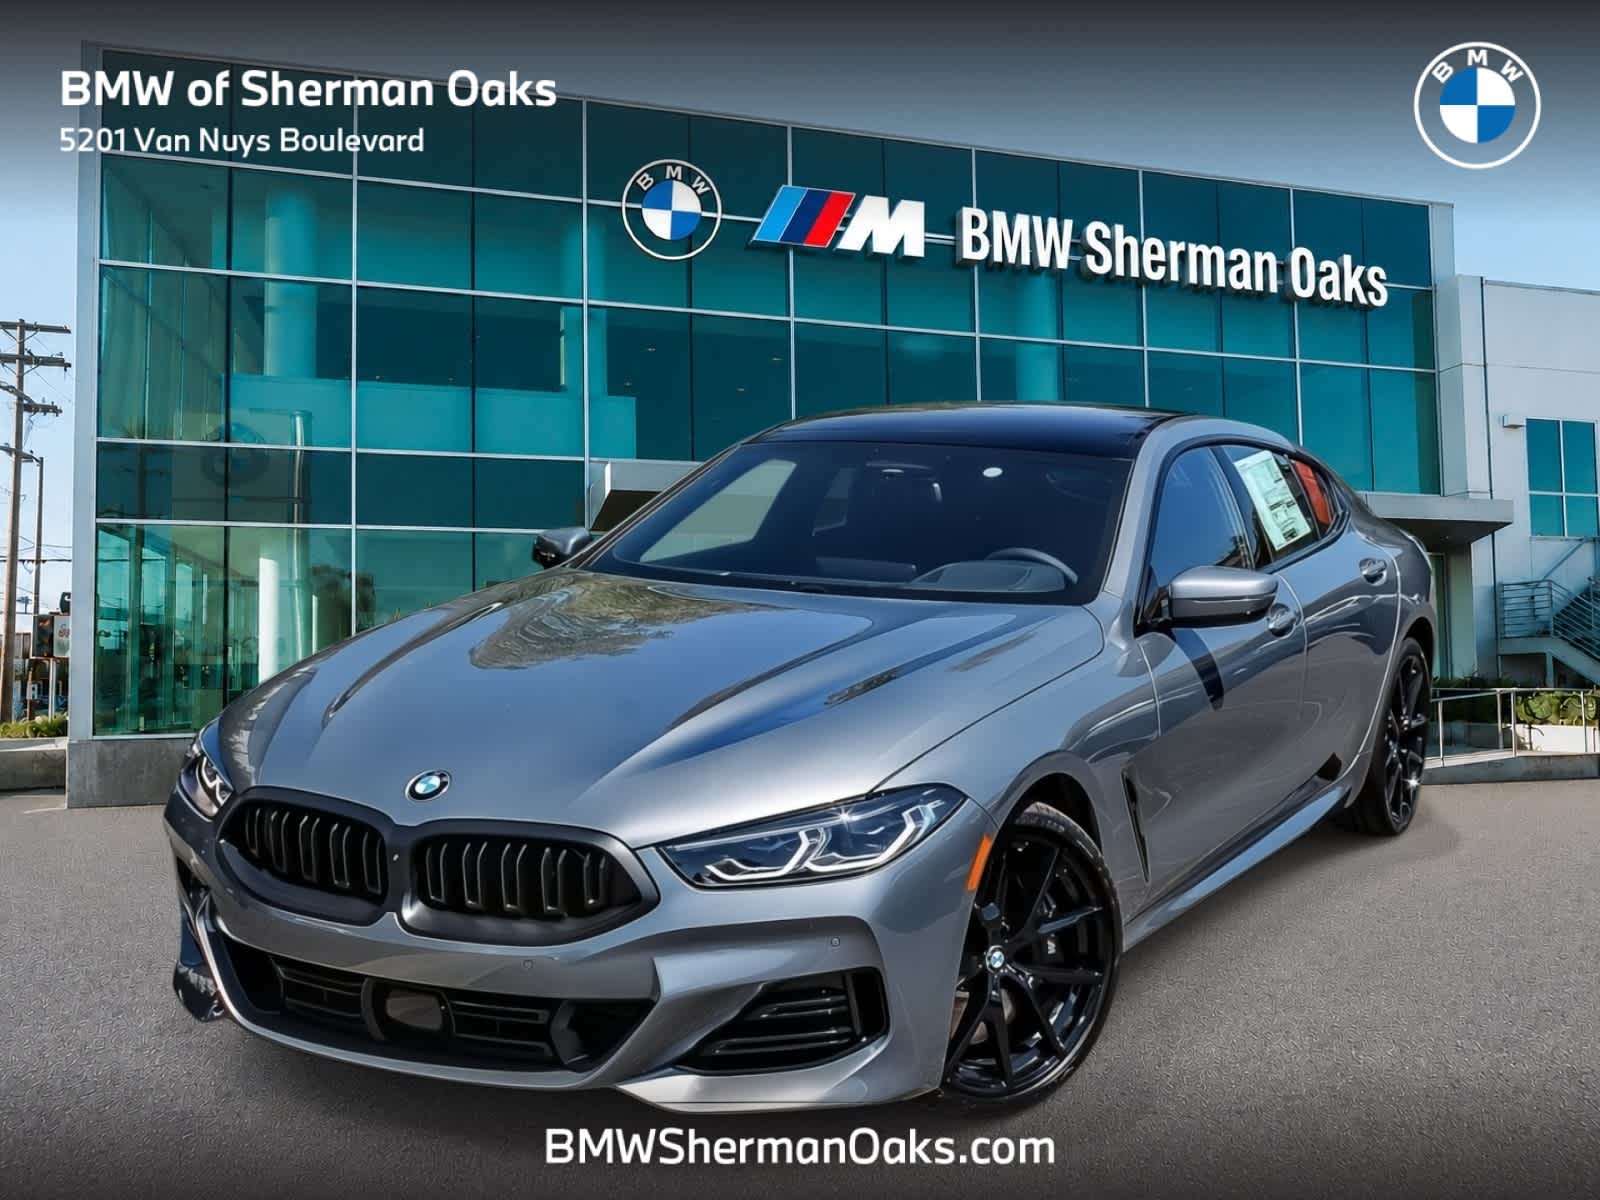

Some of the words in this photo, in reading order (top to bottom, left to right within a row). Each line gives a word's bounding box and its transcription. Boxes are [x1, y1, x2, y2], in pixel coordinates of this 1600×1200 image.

[636, 164, 711, 195] BMW
[960, 206, 1073, 270] BMW
[1084, 220, 1278, 294] Sherman
[1290, 246, 1389, 308] Oaks
